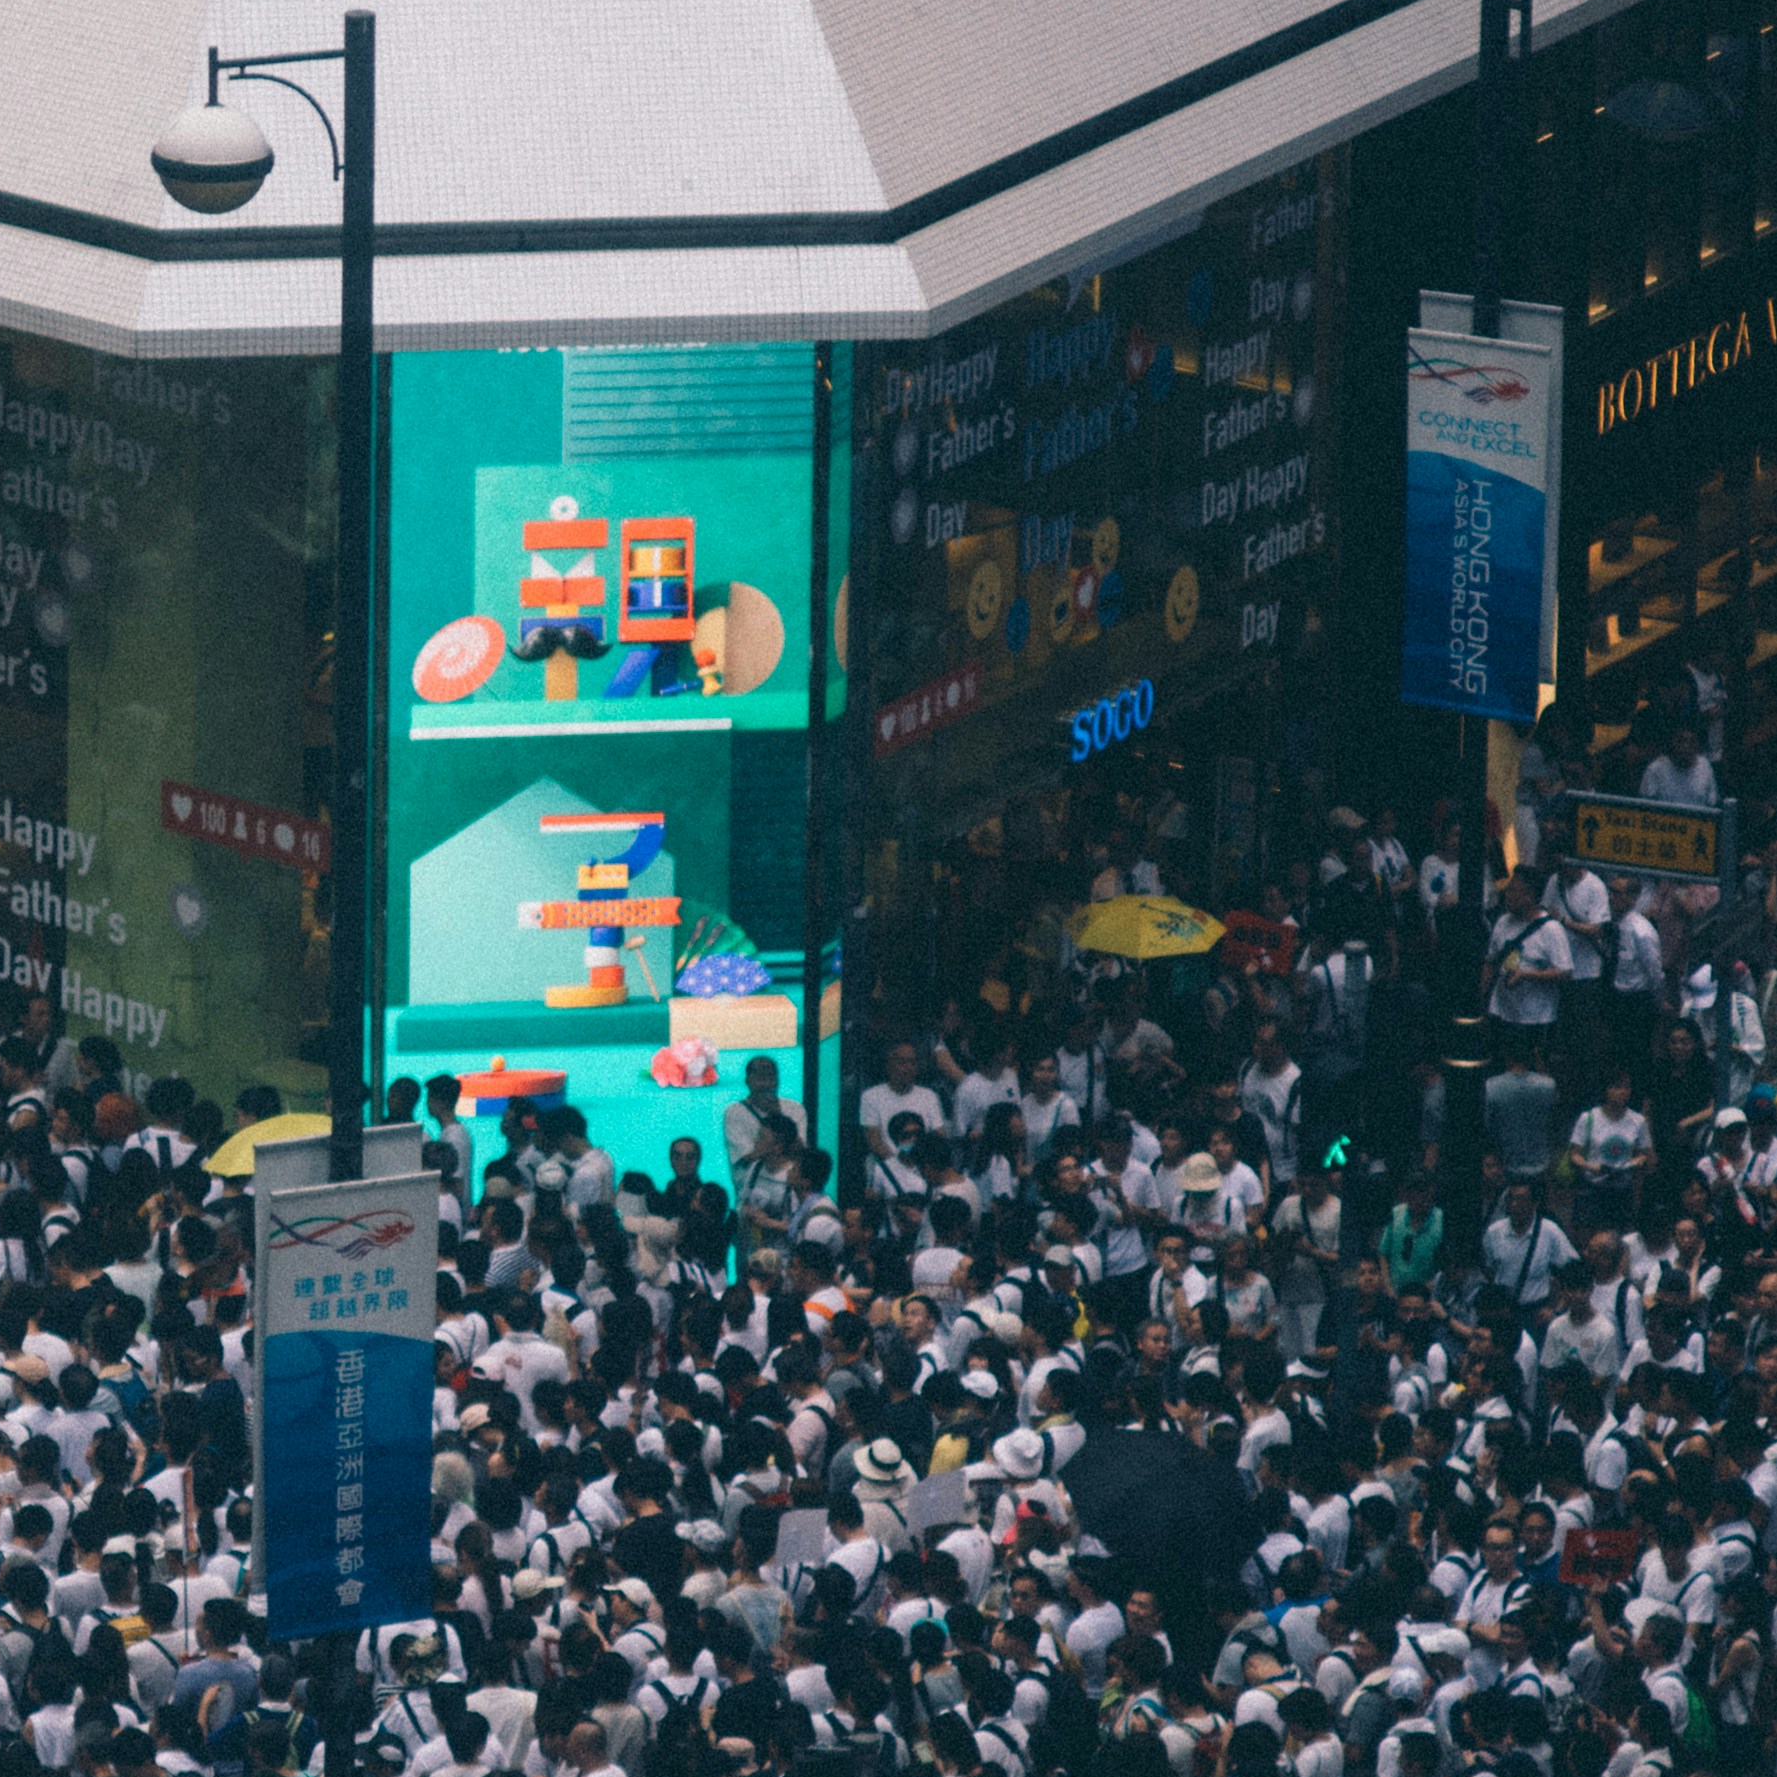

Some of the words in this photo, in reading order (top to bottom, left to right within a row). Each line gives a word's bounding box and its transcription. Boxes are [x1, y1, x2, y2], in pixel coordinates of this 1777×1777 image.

[1596, 310, 1753, 436] BOTTEGA
[91, 420, 155, 488] Day
[927, 398, 1016, 480] Father's
[1418, 409, 1521, 437] CONNECT
[1436, 429, 1468, 445] AND
[1470, 434, 1537, 459] EXCEL
[925, 500, 968, 550] Day
[1201, 479, 1241, 527] Day
[1244, 452, 1310, 510] Happy
[1242, 502, 1326, 581] Father's
[1468, 479, 1493, 584] HONG
[1239, 600, 1282, 651] Day
[1449, 553, 1468, 634] WORLD
[1448, 638, 1466, 691] CITY
[1463, 589, 1489, 695] KONG
[1070, 677, 1155, 764] SOGO
[61, 967, 167, 1049] Happy
[333, 1348, 367, 1608] 香港亞洲國際都會
